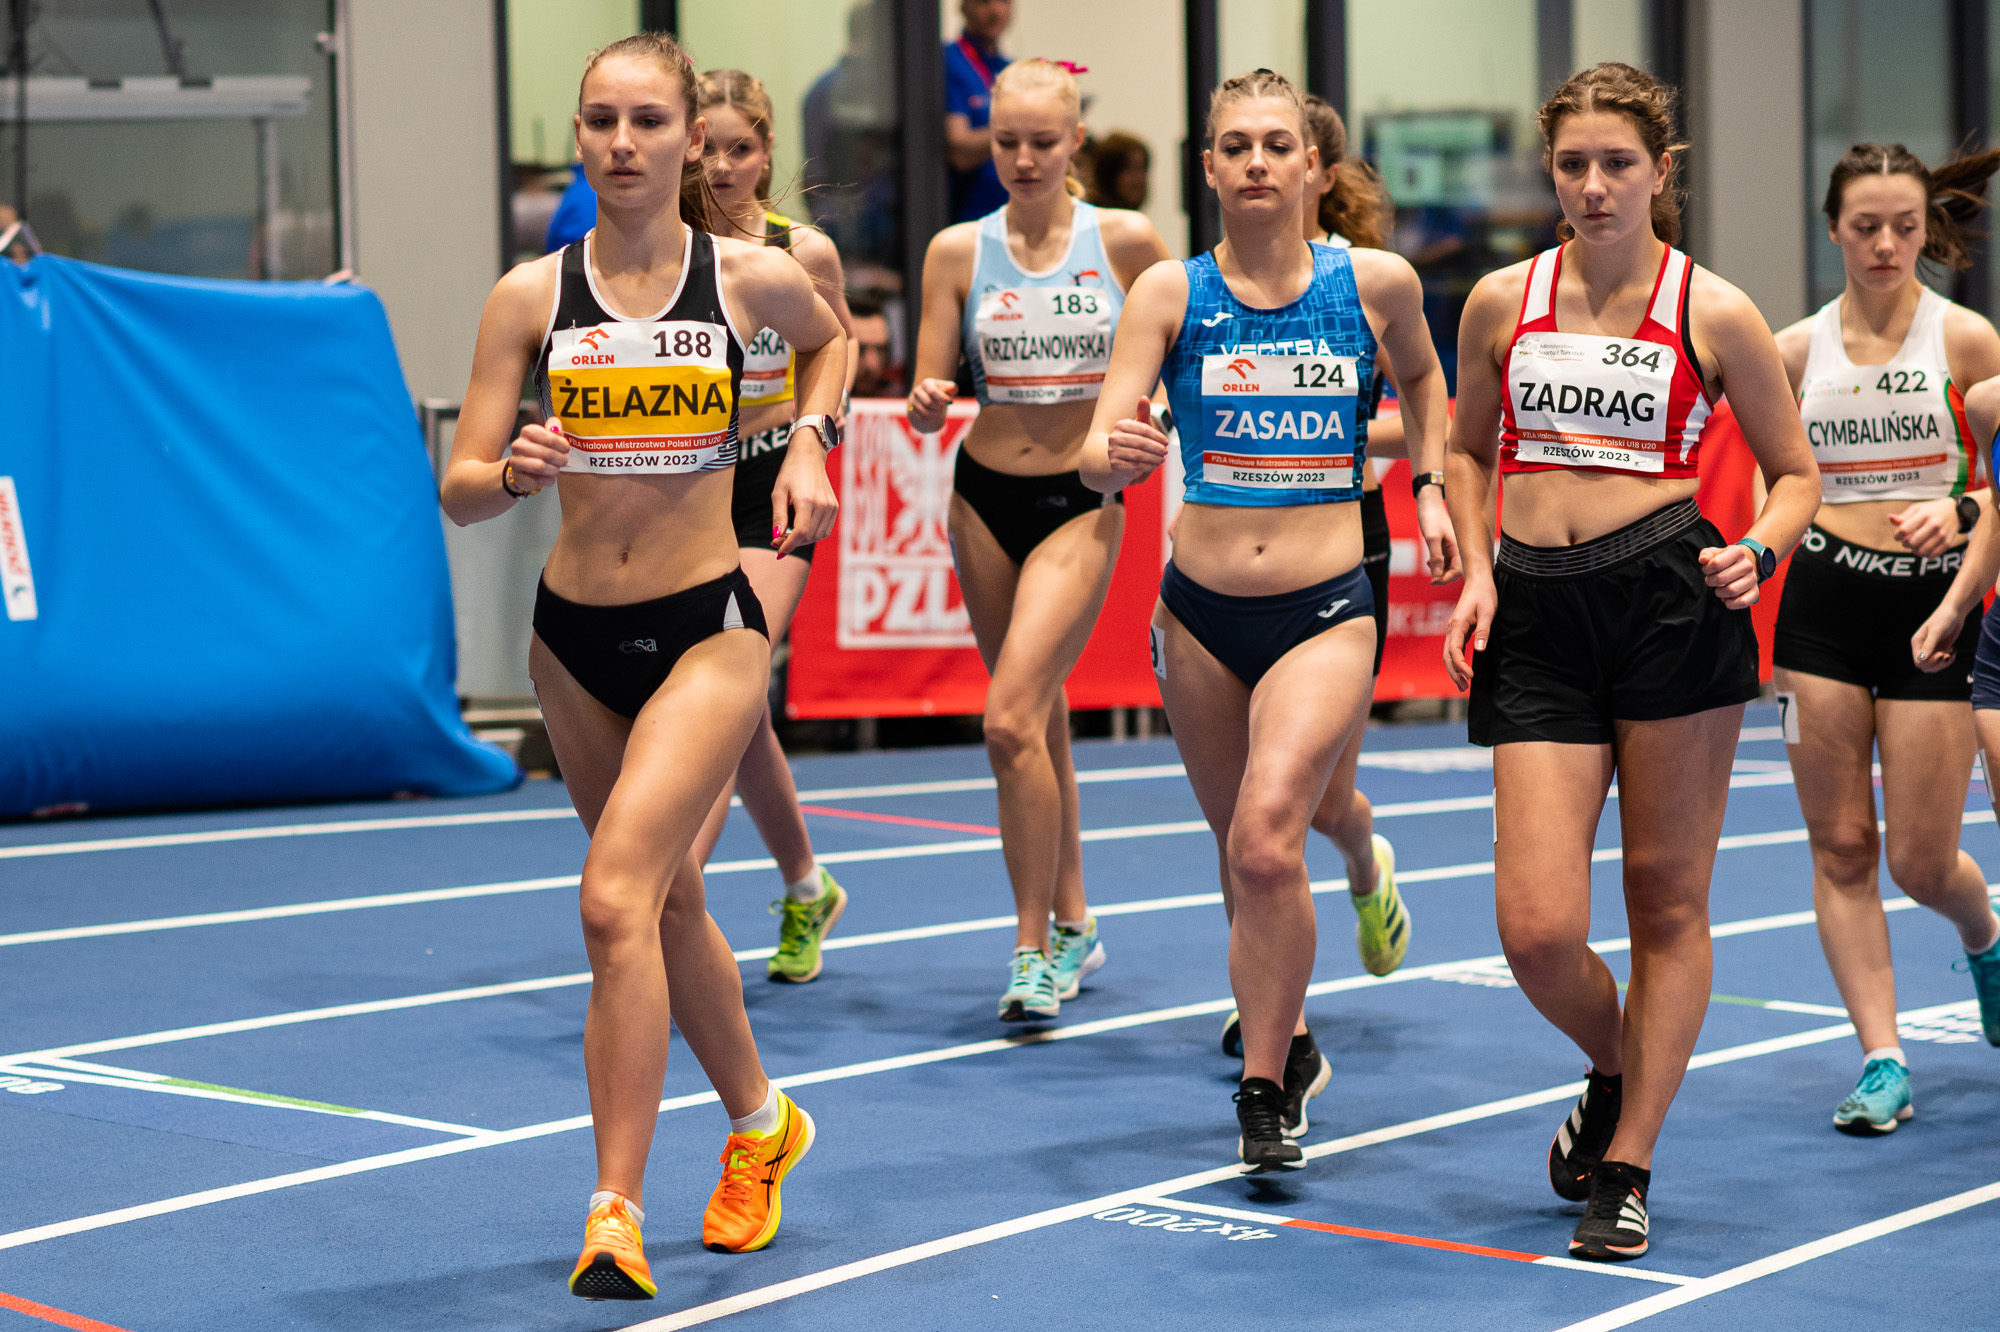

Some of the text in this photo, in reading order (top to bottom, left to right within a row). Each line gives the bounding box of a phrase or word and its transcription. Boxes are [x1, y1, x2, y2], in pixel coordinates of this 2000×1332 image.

[1052, 294, 1098, 314] 183
[652, 330, 712, 358] 188
[750, 332, 785, 355] SKA
[983, 330, 1106, 362] KRZYŻANOWSKA
[571, 354, 615, 365] ORLEN
[1601, 343, 1661, 373] 364
[1222, 384, 1260, 392] ORLEN
[1293, 364, 1345, 388] 124
[1876, 370, 1928, 394] 422
[559, 379, 727, 419] ŻELAZNA
[1518, 382, 1656, 427] ZADRĄG
[1215, 410, 1345, 440] ZASADA
[1808, 410, 1940, 448] CYMBALIŃSKA
[583, 442, 613, 450] Halowe
[615, 440, 665, 449] Mistrzostwa
[667, 439, 692, 448] Polski
[693, 438, 707, 447] U18
[708, 435, 721, 444] U20
[741, 427, 789, 460] IKE
[1543, 445, 1630, 462] RZESZÓW 2023
[1603, 438, 1625, 447] Polski
[1627, 440, 1640, 448] U18
[1641, 442, 1657, 450] U20
[589, 453, 698, 467] RZESZÓW 2023
[1211, 455, 1228, 464] PZLA
[1229, 458, 1255, 466] Halowe
[1256, 459, 1299, 467] Mistrzostwa
[1300, 459, 1321, 467] Polski
[1232, 471, 1325, 482] RZESZÓW 2023
[1835, 471, 1920, 486] RZESZÓW 2023
[1834, 545, 1916, 577] NIKE
[1919, 550, 1966, 576] PR
[853, 570, 967, 629] PZL
[1093, 1207, 1278, 1241] 4x200
